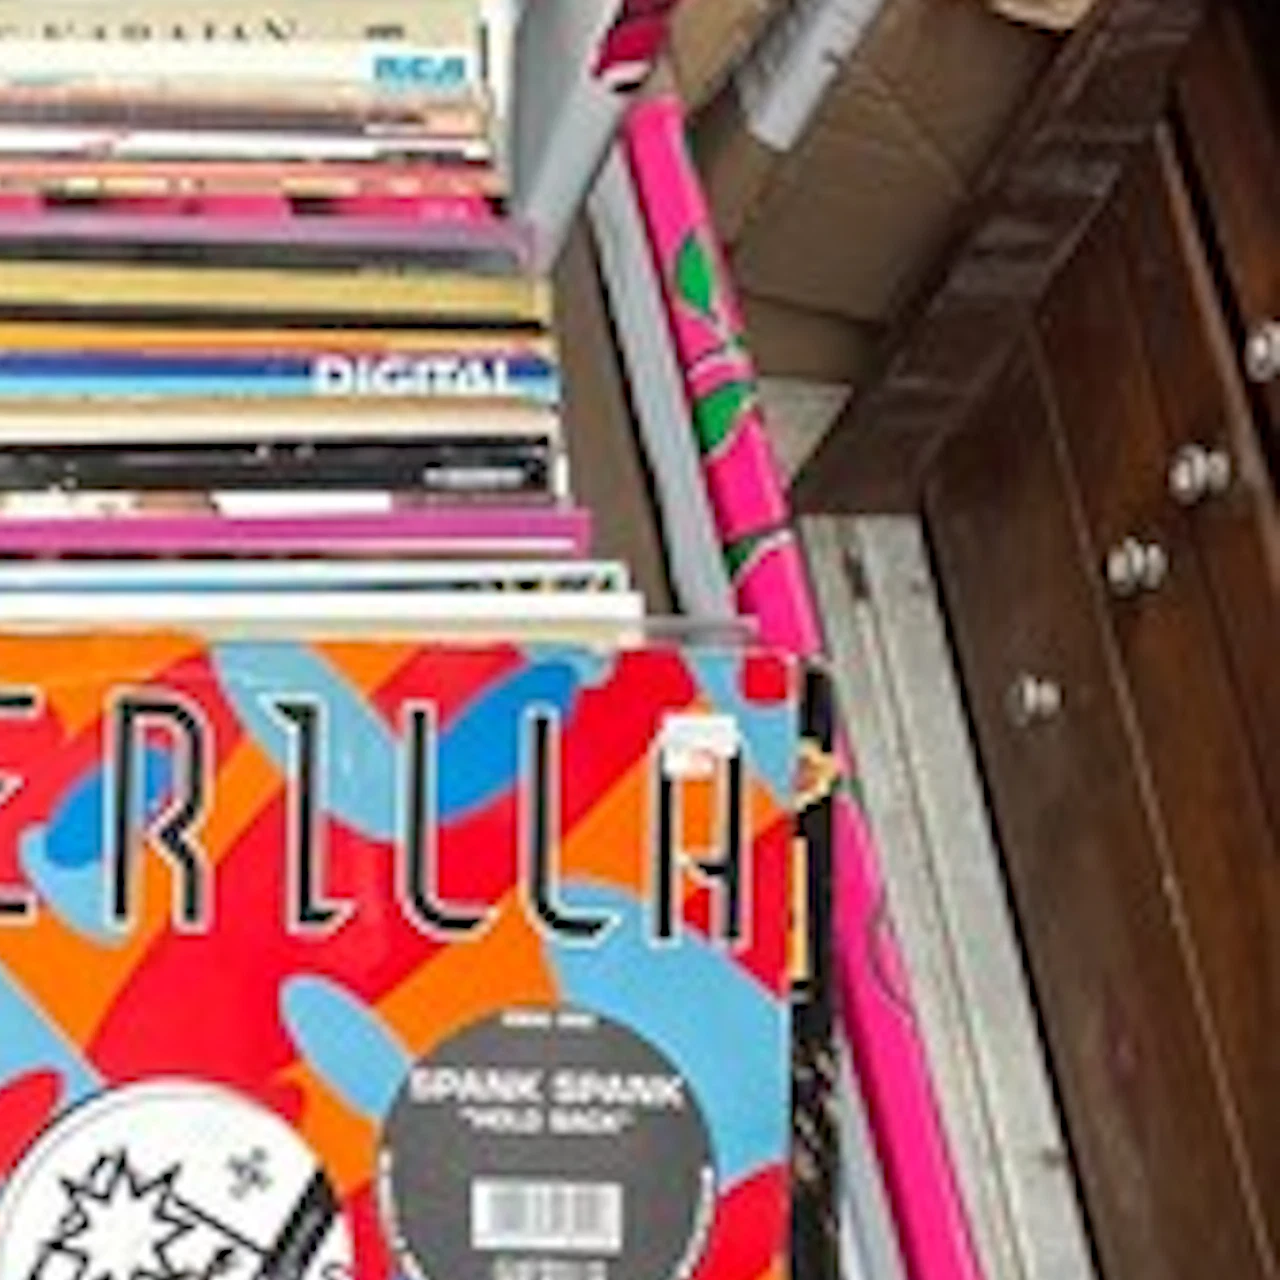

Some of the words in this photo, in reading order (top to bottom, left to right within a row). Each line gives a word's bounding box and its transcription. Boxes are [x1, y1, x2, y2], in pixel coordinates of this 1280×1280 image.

[311, 354, 516, 397] DIGITAL
[409, 1067, 543, 1104] SPANK
[552, 1070, 687, 1112] SPANK
